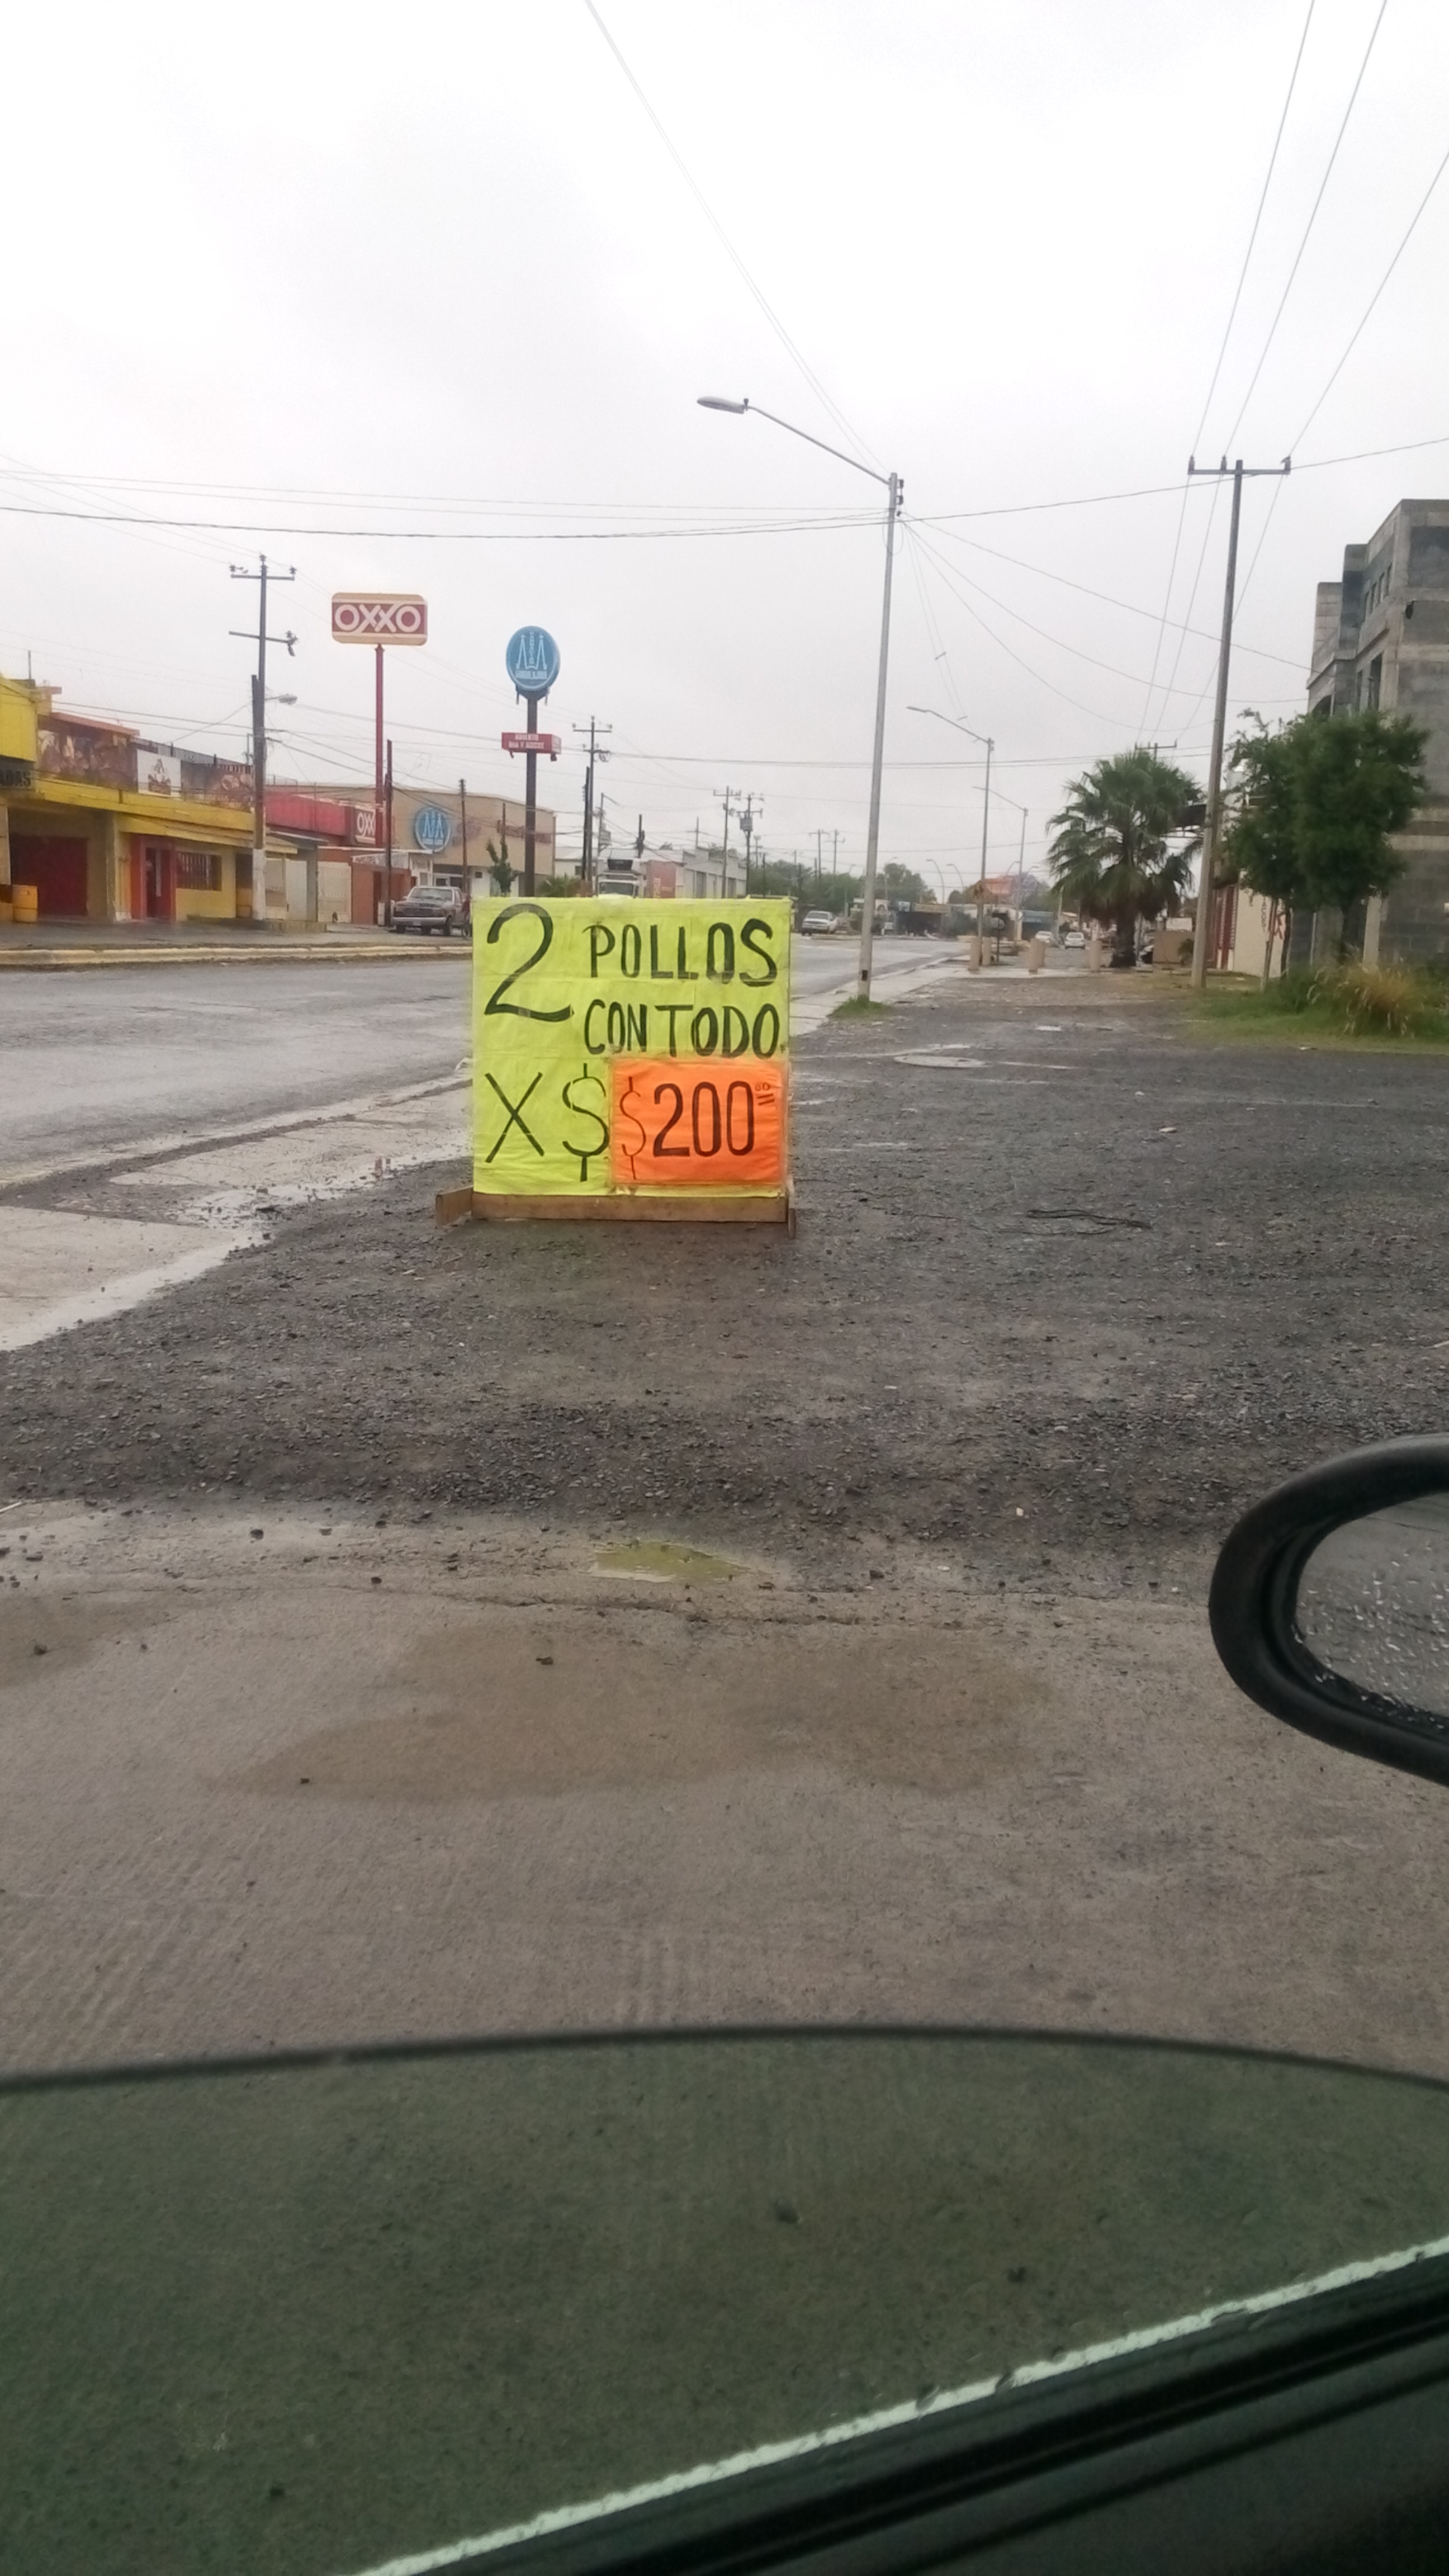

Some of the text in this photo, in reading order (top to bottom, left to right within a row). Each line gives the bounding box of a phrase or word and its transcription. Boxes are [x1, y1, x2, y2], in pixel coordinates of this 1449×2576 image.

[335, 602, 422, 633] OXXO
[357, 811, 375, 836] OXX
[484, 903, 778, 1022] 2 POLLOS
[485, 1063, 610, 1182] X $
